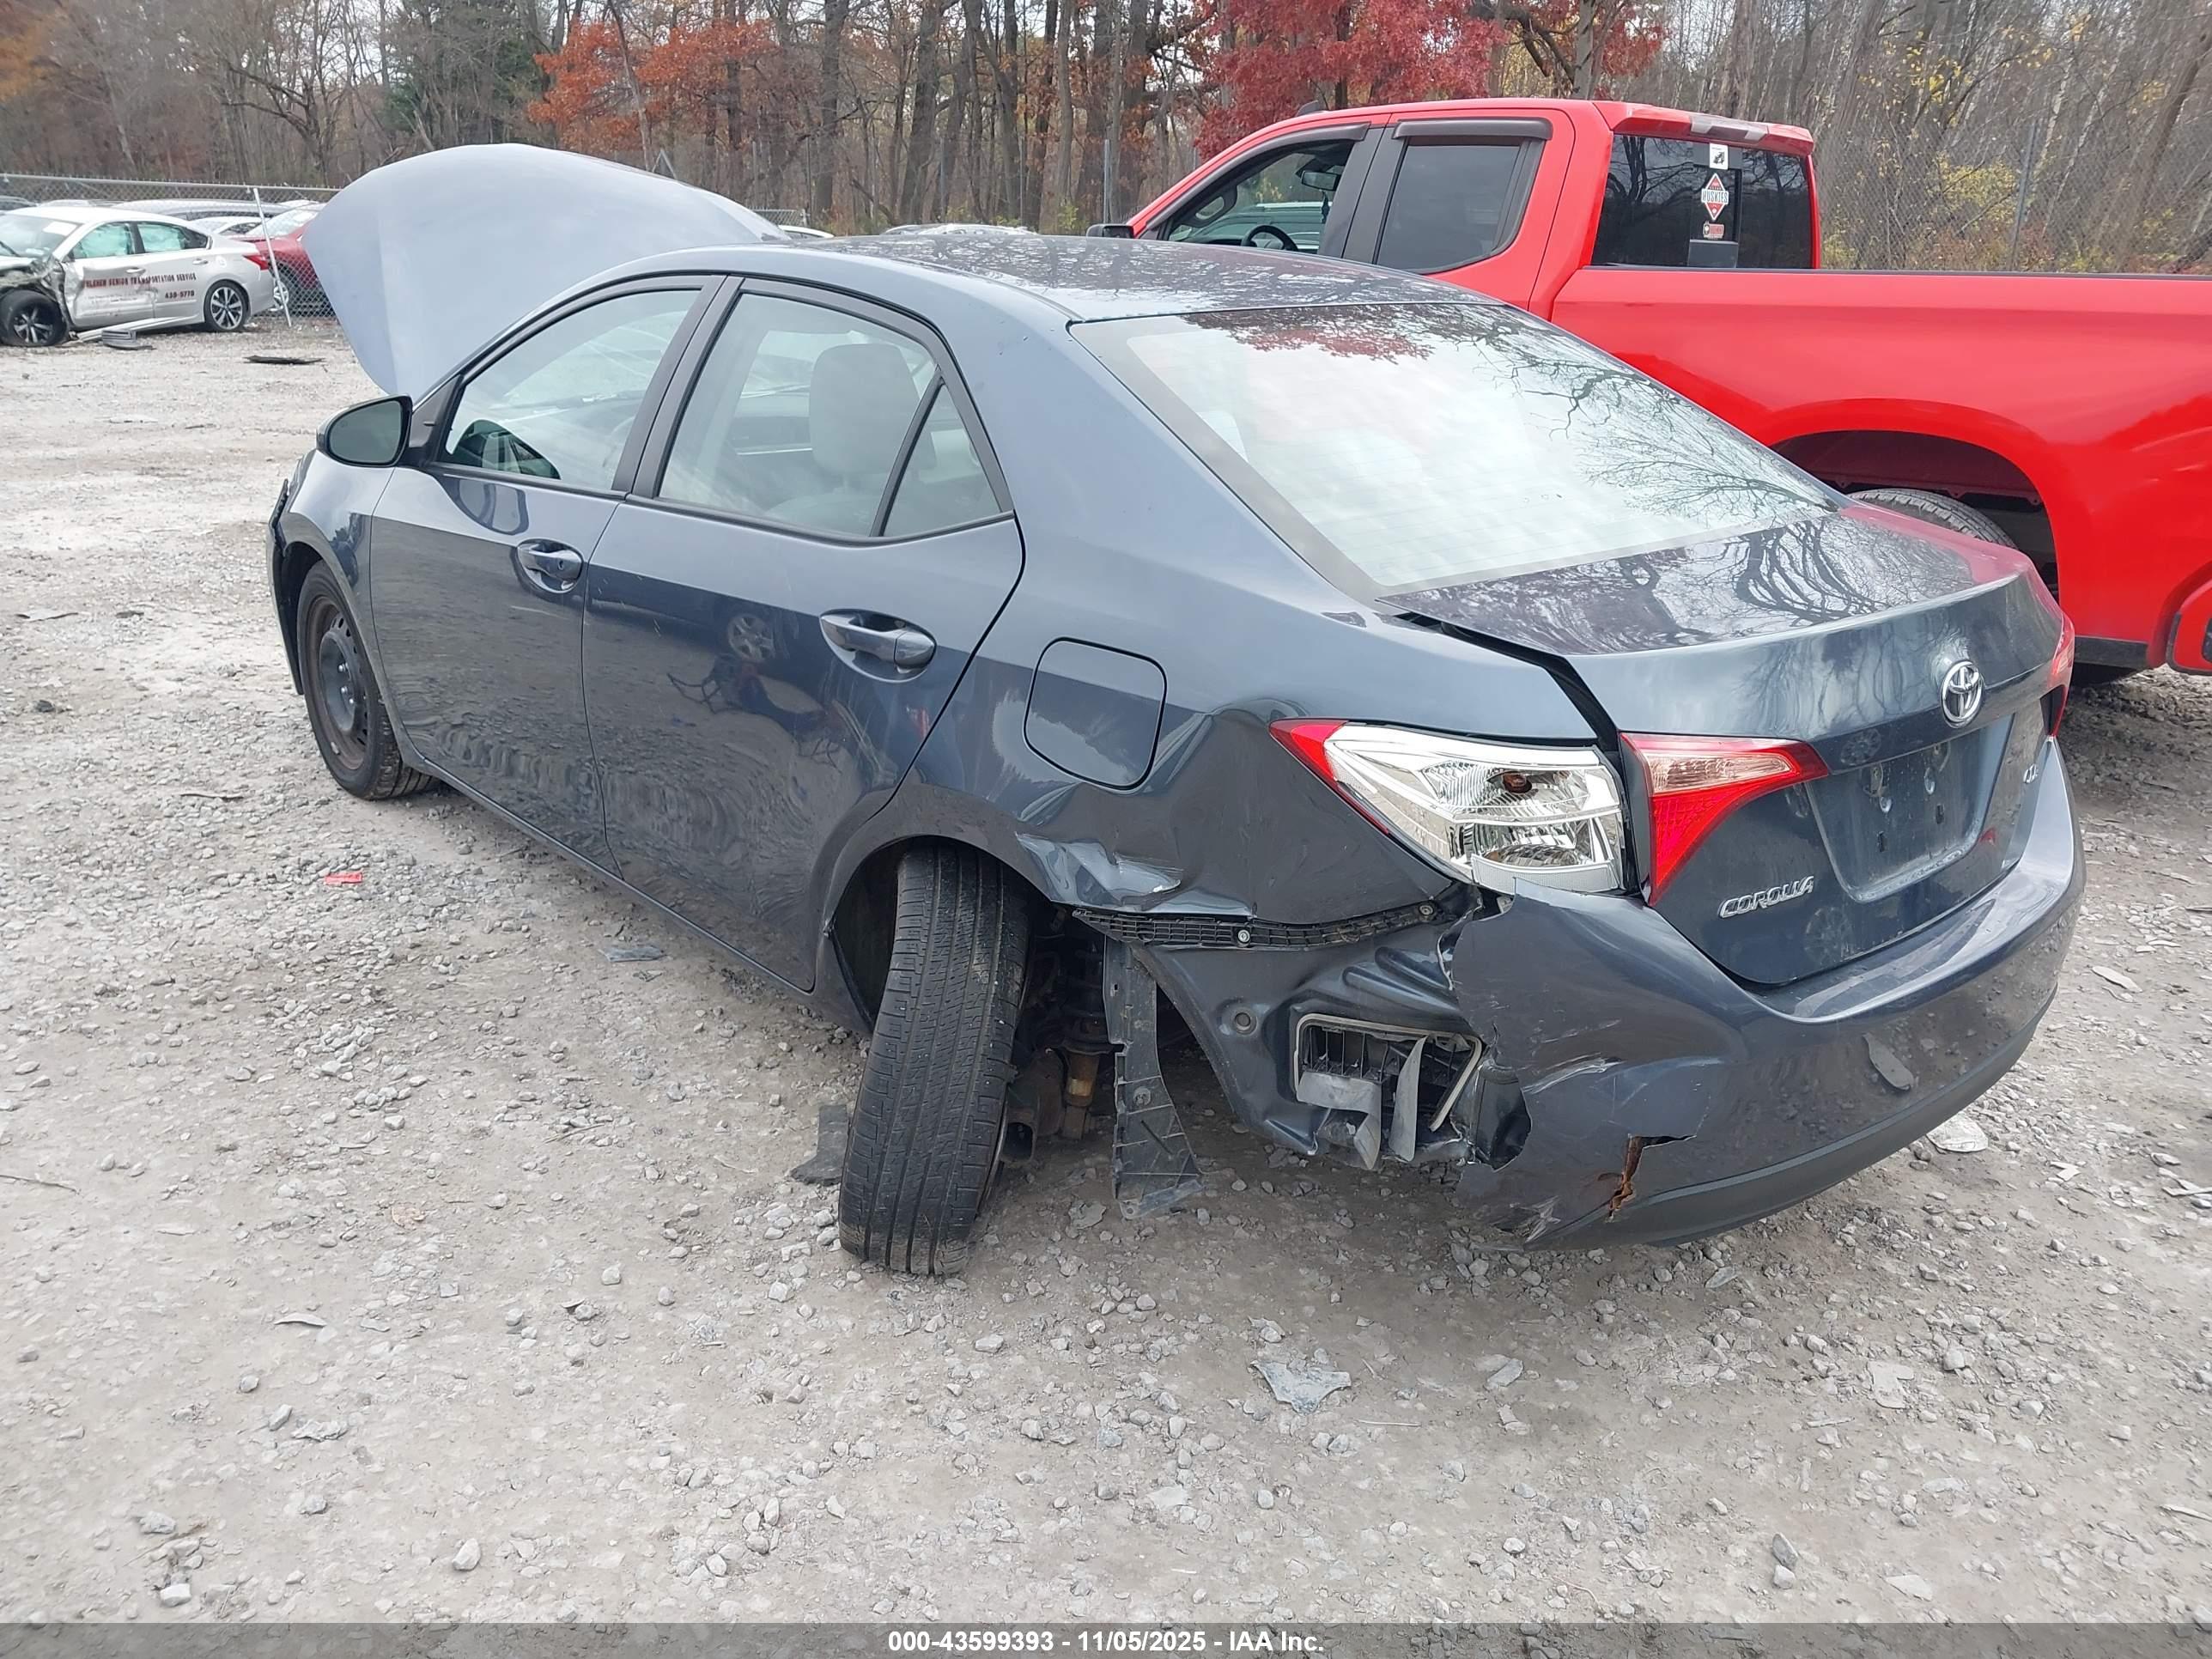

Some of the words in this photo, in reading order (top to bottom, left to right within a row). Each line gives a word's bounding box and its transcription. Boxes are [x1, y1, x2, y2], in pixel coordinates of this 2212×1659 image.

[1702, 190, 1728, 204] HUSKIES
[109, 277, 129, 286] SENIOR
[131, 274, 175, 285] TRANSPORTATION
[176, 272, 197, 282] SERVICE
[1718, 875, 1814, 919] COROLLA
